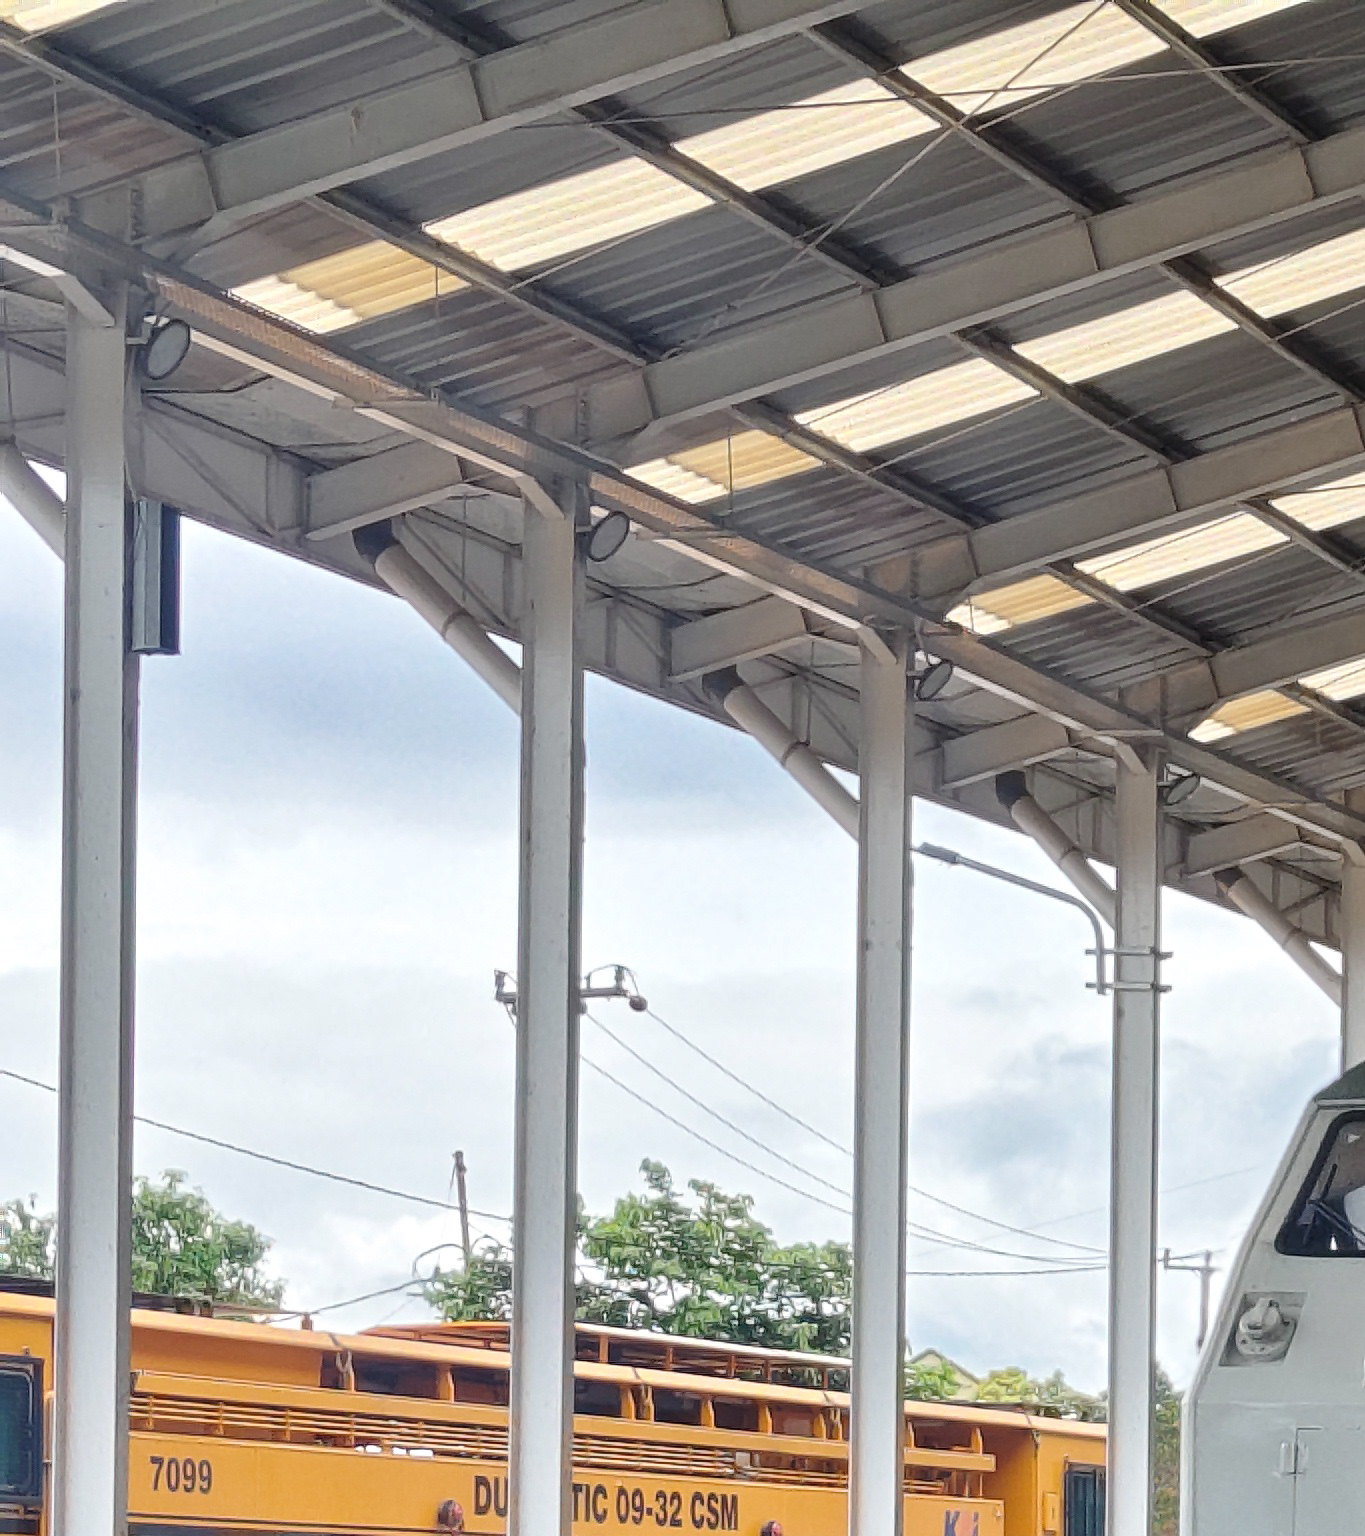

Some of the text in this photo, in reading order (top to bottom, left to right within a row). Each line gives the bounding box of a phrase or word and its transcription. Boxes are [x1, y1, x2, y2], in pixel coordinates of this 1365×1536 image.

[150, 1455, 213, 1495] 7099
[474, 1475, 739, 1531] DUTIC 09-32 CSM
